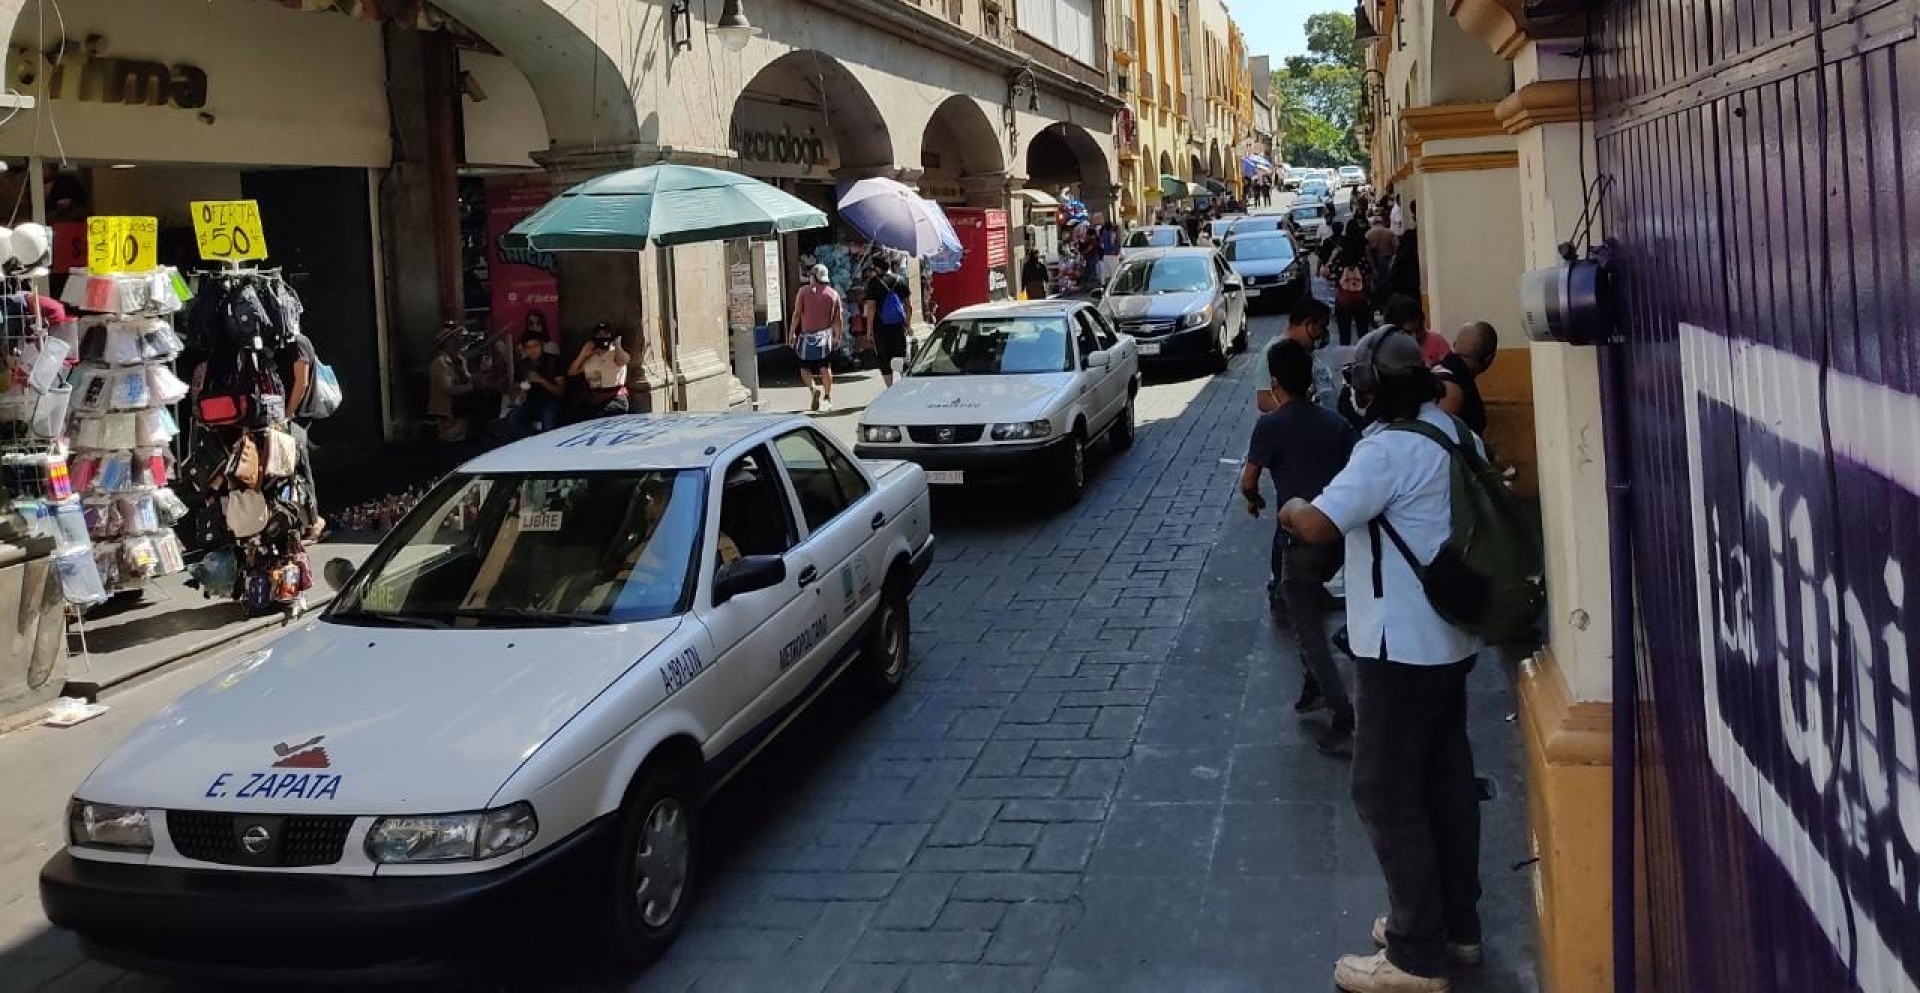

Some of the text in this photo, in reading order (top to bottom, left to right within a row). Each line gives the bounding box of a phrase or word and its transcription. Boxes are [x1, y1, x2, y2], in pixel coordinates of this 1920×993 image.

[203, 203, 256, 225] OFERTA
[523, 515, 559, 528] LIBRE
[205, 773, 342, 800] E. ZAPATA
